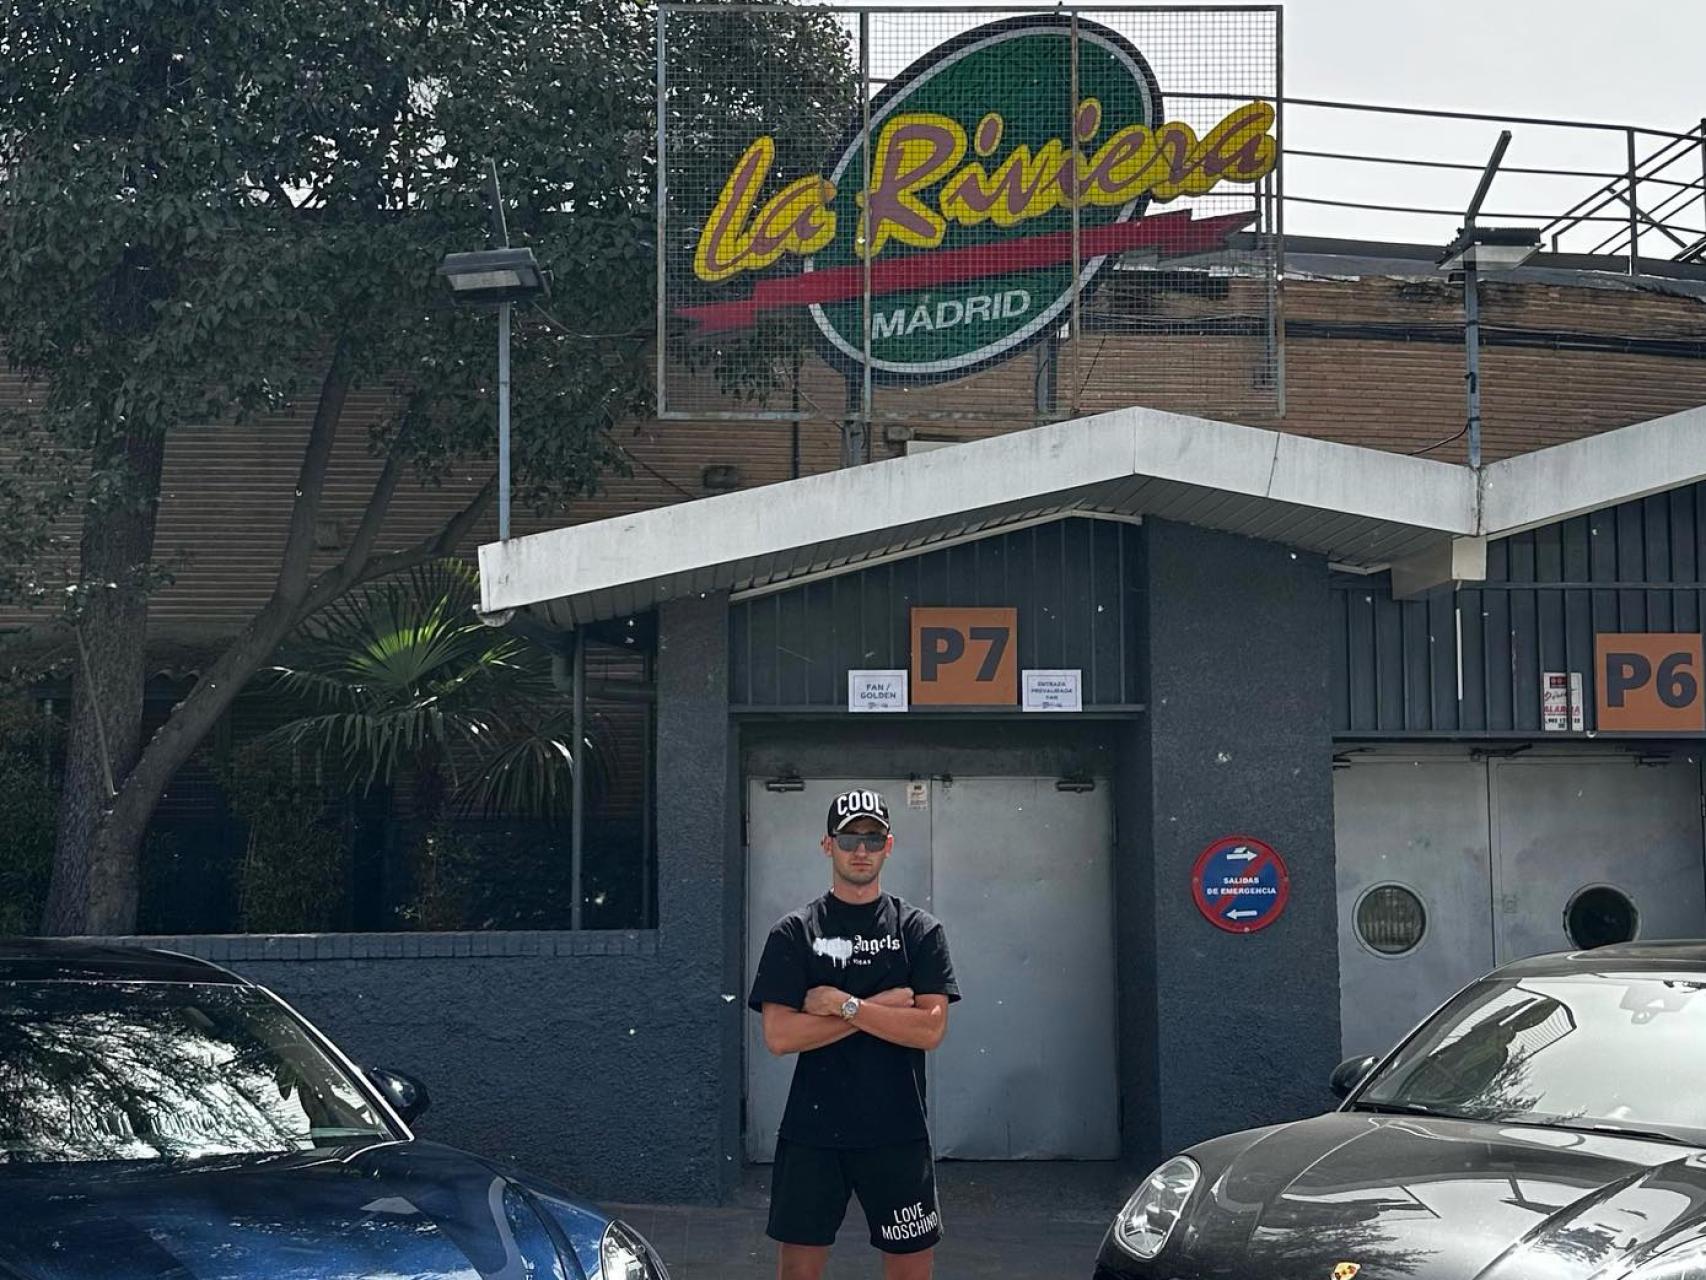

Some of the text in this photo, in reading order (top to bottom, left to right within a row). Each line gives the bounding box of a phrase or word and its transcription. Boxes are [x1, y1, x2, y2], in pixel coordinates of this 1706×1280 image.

[855, 97, 1278, 259] Riviera
[871, 290, 1031, 340] MADRID
[920, 627, 1010, 682] P7
[866, 683, 884, 691] FAN
[1606, 652, 1698, 708] P6
[860, 691, 896, 699] GOLDEN
[837, 791, 884, 816] COOL
[1206, 887, 1277, 895] DE EMERGENCIA
[853, 934, 901, 956] Angels
[893, 1201, 925, 1224] LOVE
[881, 1210, 938, 1241] MOSCHINO
